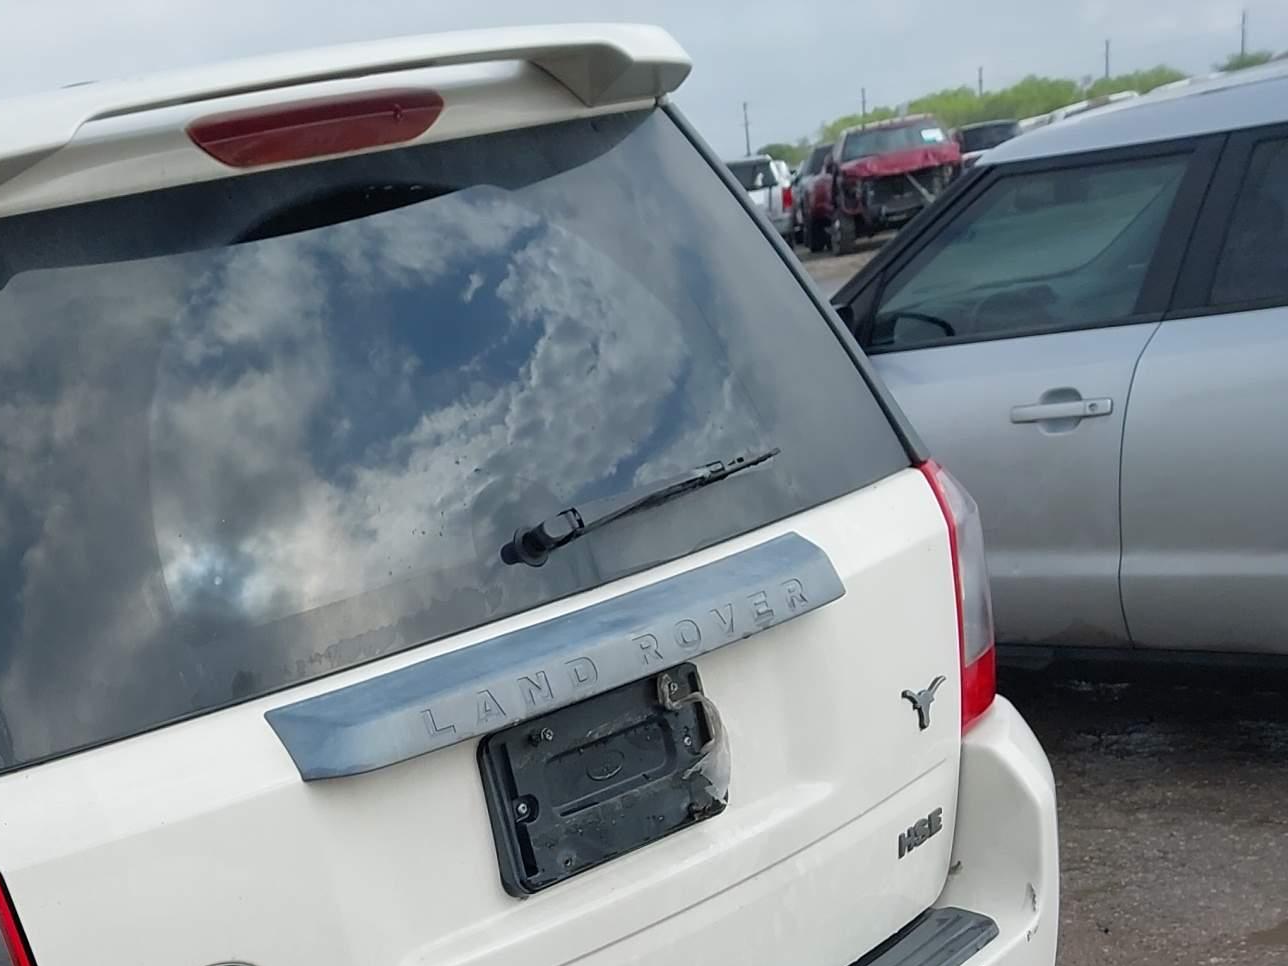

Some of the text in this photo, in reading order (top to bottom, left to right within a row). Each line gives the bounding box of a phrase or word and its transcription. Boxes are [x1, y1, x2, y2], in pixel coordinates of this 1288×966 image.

[420, 578, 809, 736] LAND ROVER
[898, 807, 943, 859] HSE
